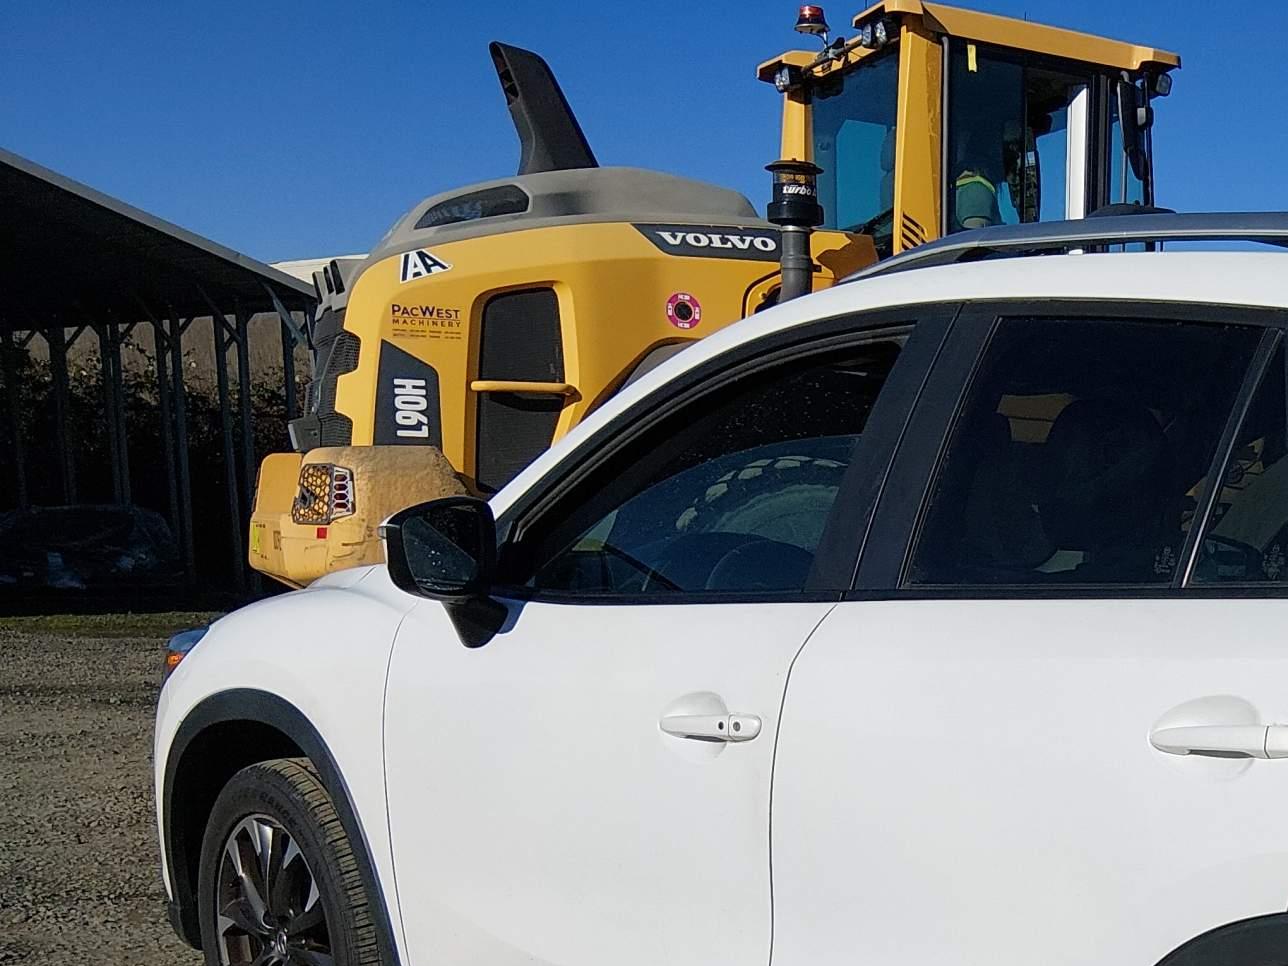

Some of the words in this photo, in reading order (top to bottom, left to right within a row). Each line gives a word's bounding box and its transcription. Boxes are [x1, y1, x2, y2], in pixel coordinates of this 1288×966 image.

[656, 231, 777, 251] VOLVO
[392, 318, 461, 328] MACHINERY
[393, 378, 429, 438] L90H
